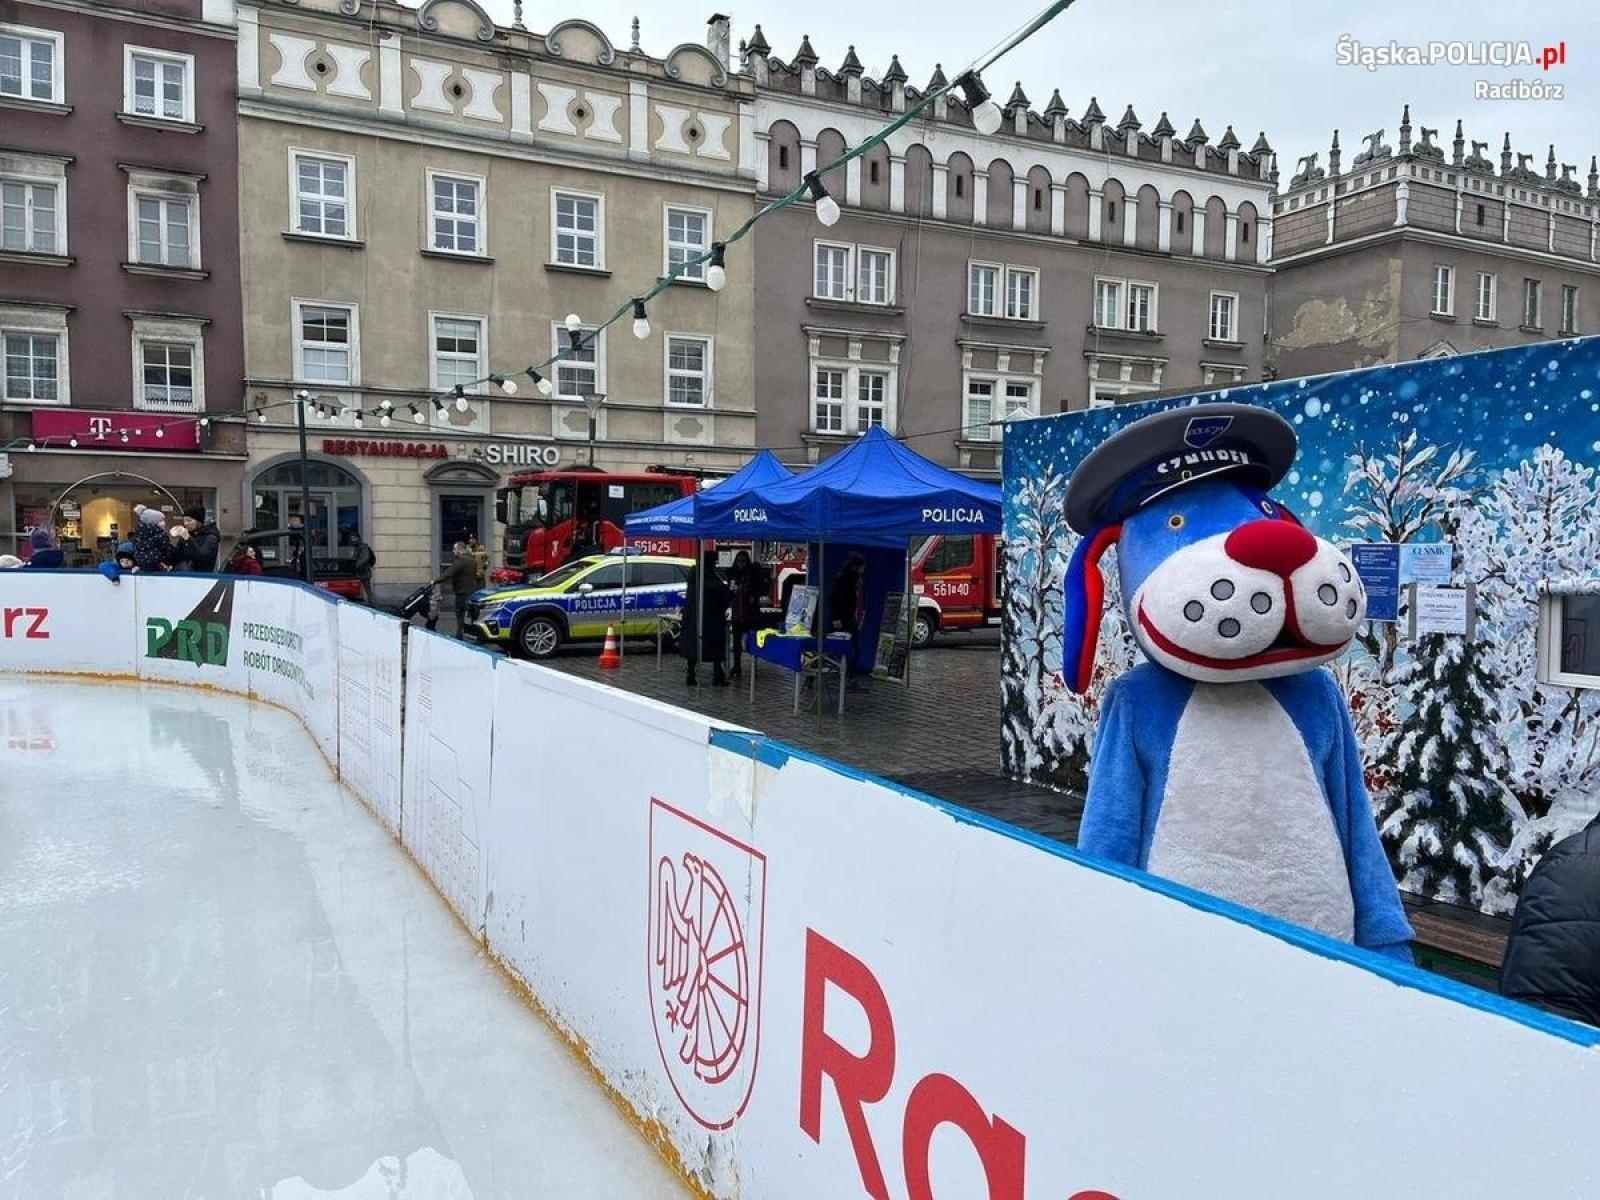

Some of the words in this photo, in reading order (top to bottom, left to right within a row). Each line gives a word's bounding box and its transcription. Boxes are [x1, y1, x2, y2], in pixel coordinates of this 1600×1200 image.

[90, 417, 112, 440] T
[322, 439, 449, 459] RESTAURACJA
[486, 443, 560, 465] SHIRO
[734, 508, 768, 523] POLICJA
[921, 508, 985, 523] POLICJA
[575, 598, 617, 610] POLICJA
[3, 607, 50, 639] rz
[145, 617, 231, 667] PRD
[243, 649, 272, 672] ROBÓT
